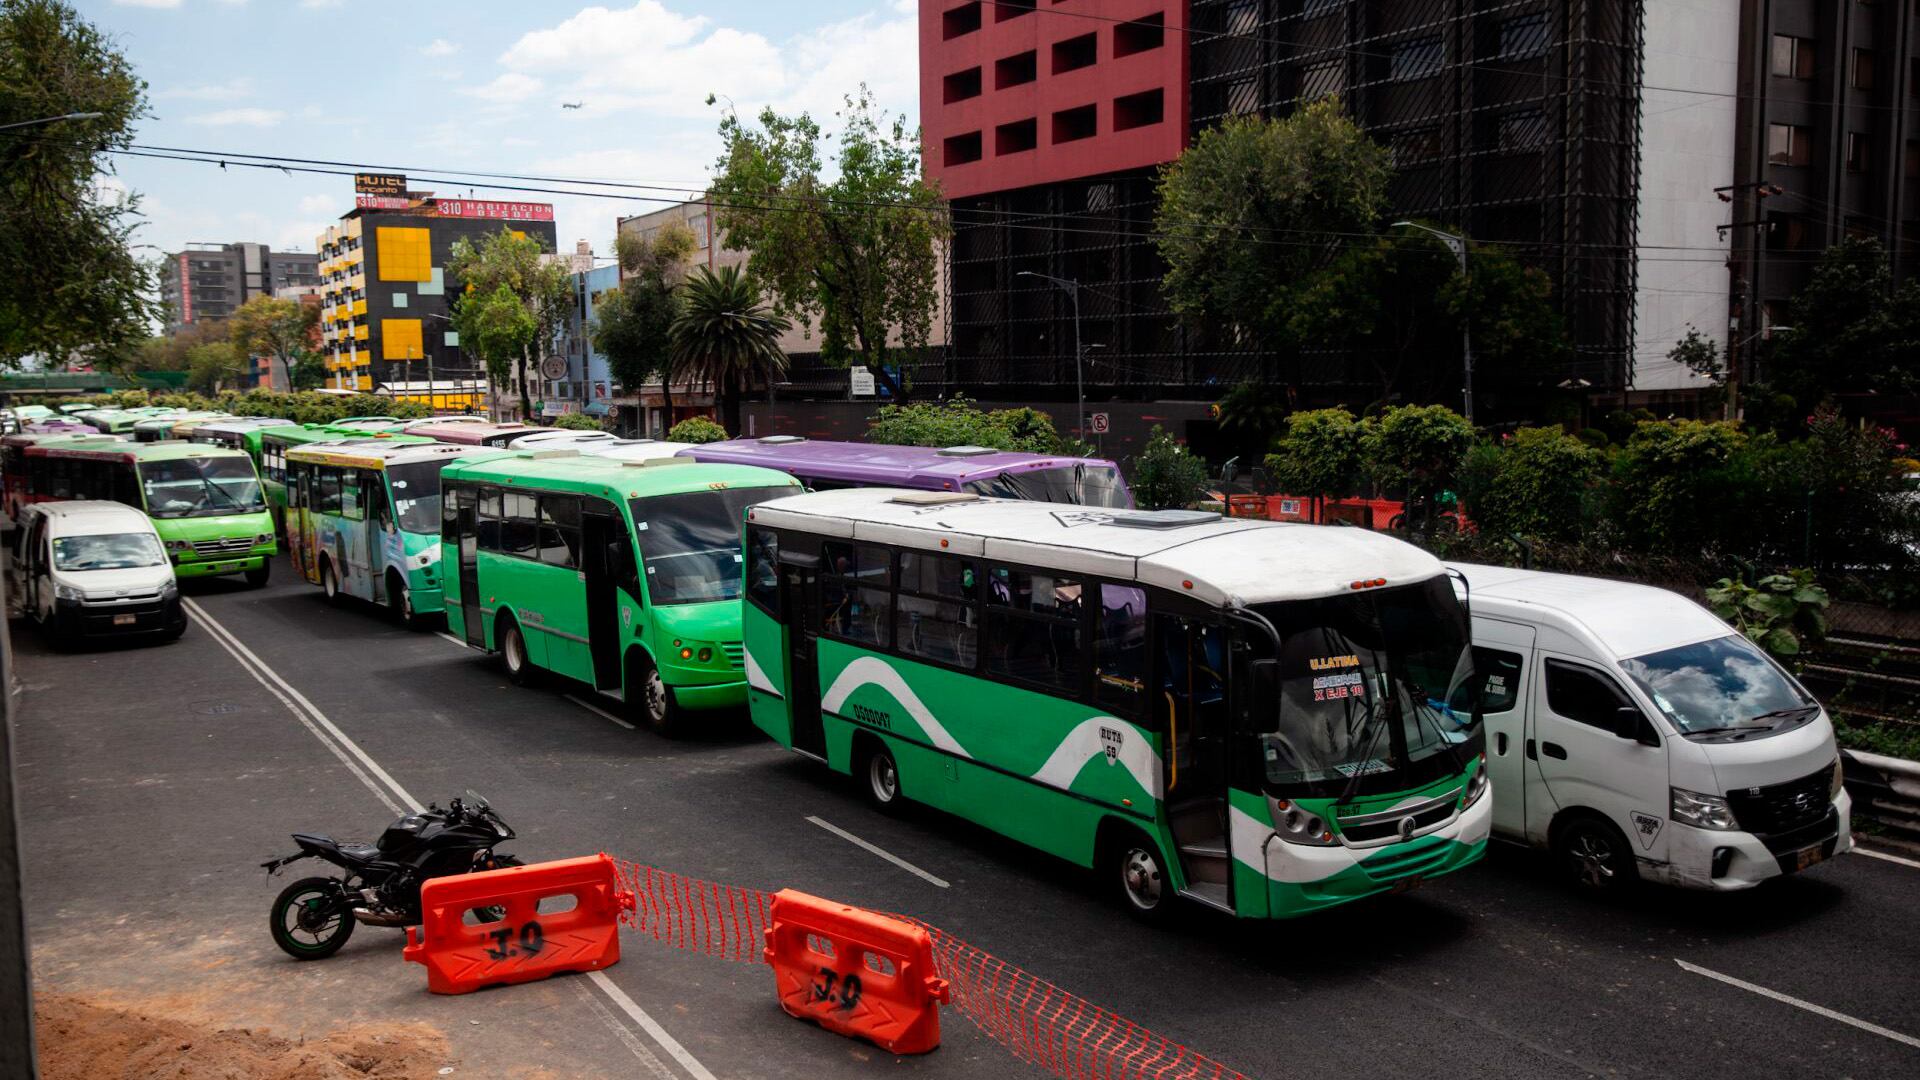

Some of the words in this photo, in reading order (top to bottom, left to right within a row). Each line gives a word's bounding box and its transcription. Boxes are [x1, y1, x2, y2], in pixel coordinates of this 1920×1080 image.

[438, 201, 462, 215] $310
[478, 210, 532, 218] DESDE
[1314, 690, 1325, 701] X
[1326, 686, 1349, 700] EJE
[1101, 728, 1122, 744] RUTA
